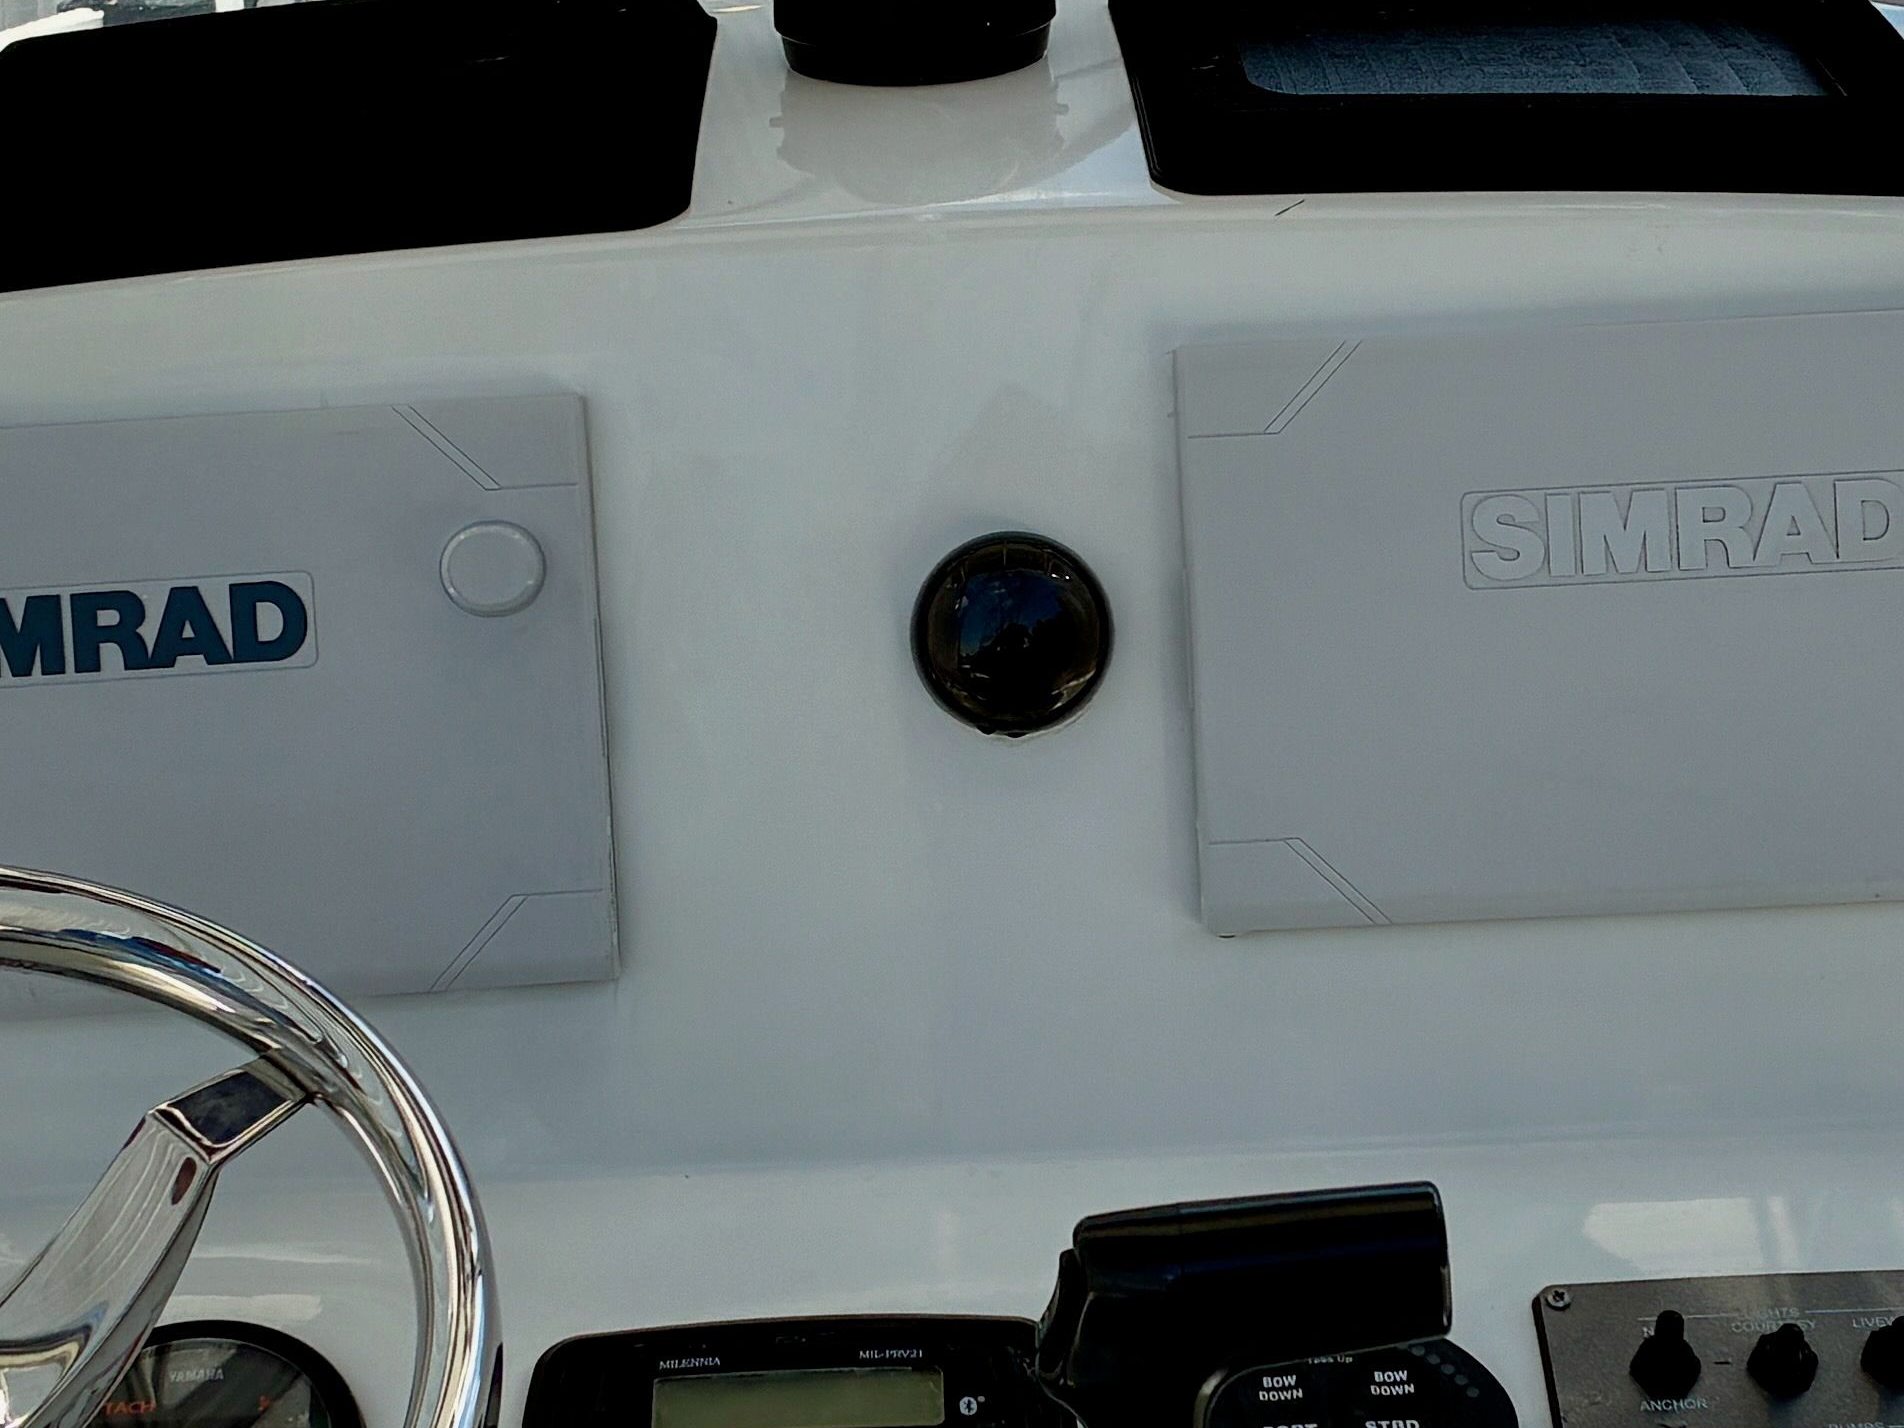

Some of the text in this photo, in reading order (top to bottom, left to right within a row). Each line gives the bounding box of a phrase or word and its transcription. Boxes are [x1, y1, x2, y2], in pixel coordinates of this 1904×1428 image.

[170, 1369, 224, 1382] YAMAHA
[1263, 1375, 1297, 1388] BOW
[1374, 1370, 1408, 1383] BOW
[1259, 1388, 1303, 1402] DOWN
[1370, 1383, 1415, 1396] DOWN
[103, 1400, 158, 1416] TACH
[1640, 1399, 1708, 1413] ANCHOR
